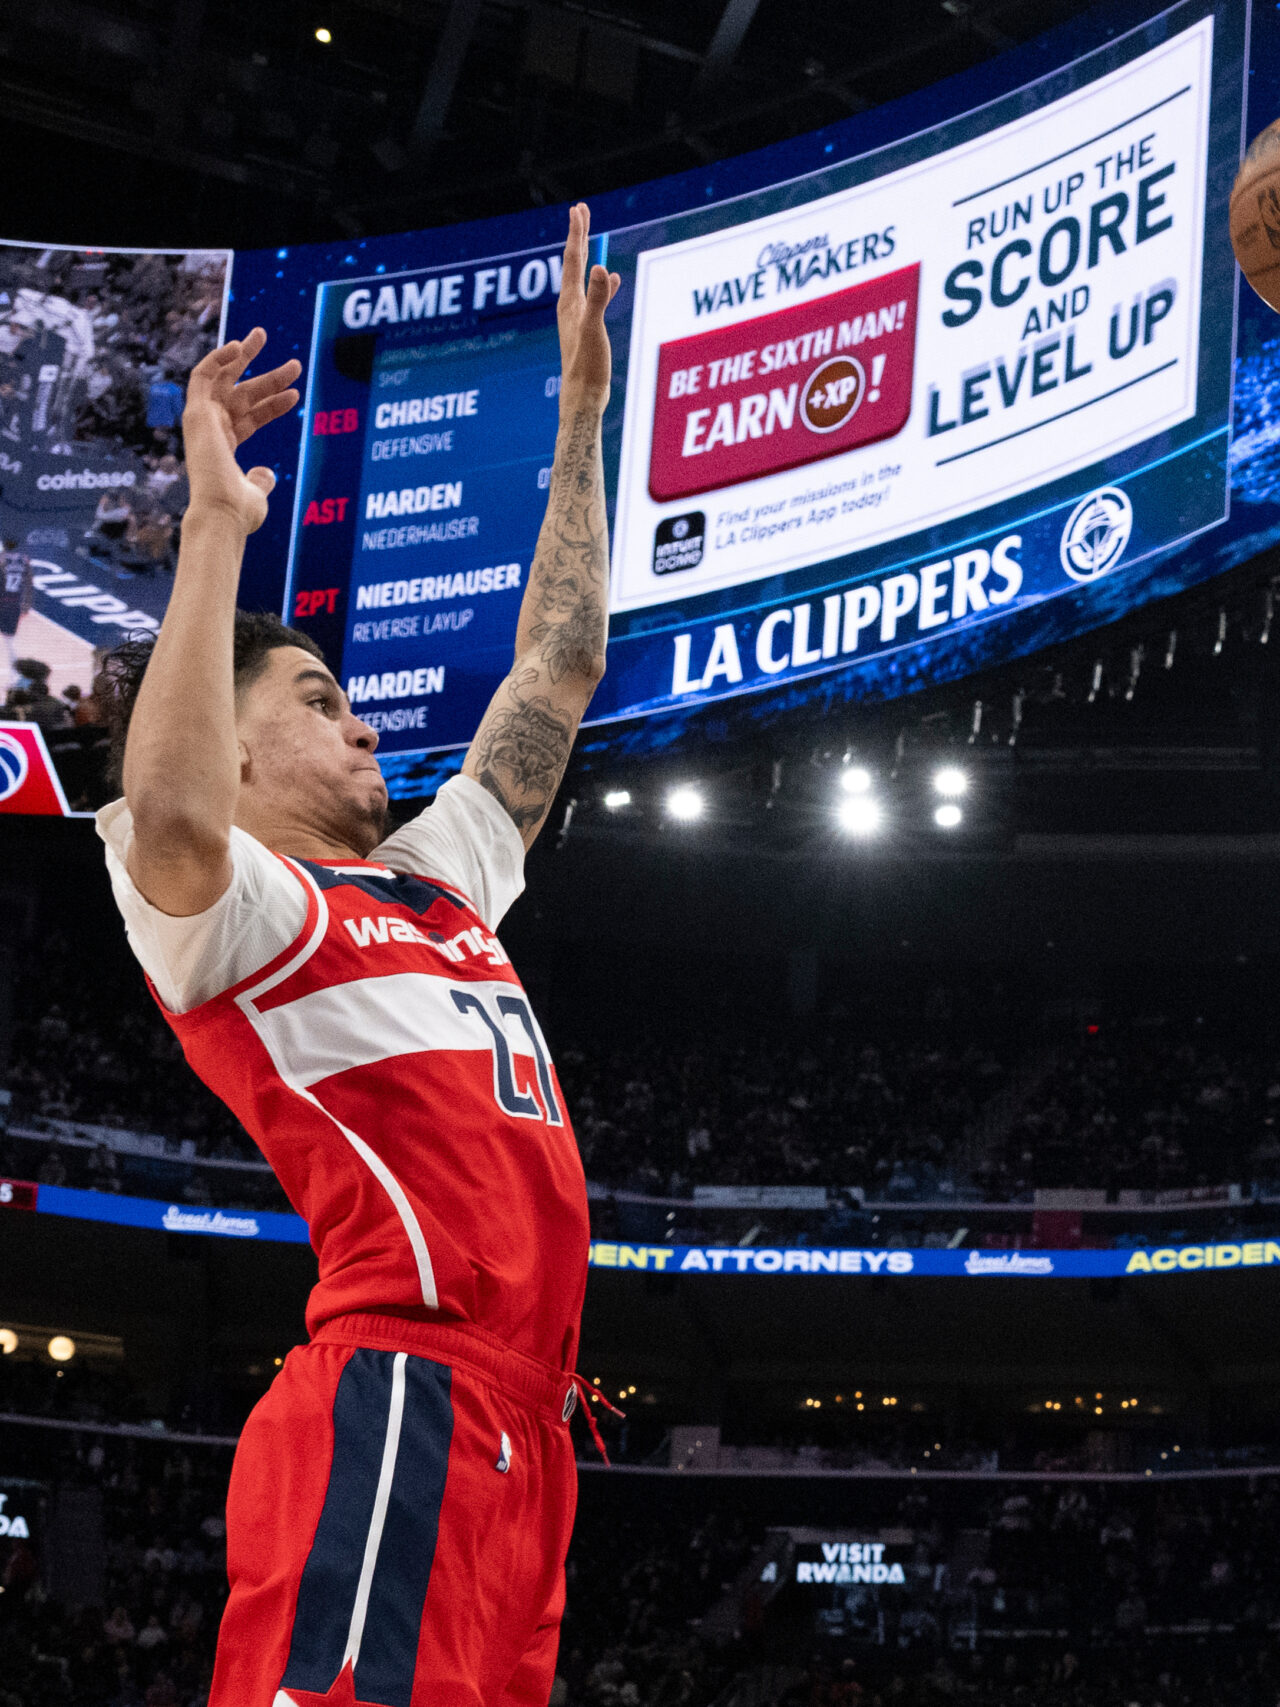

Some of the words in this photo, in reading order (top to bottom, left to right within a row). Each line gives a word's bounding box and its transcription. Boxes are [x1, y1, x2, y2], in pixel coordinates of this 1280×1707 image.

[967, 194, 1033, 250] RUN
[1043, 172, 1085, 214] UP
[1094, 132, 1157, 189] THE
[941, 161, 1176, 329] SCORE
[692, 269, 767, 317] WAVE
[776, 225, 896, 294] MAKERS
[343, 275, 464, 329] GAME
[1021, 284, 1091, 341] AND
[668, 365, 704, 399] BE
[708, 350, 757, 389] THE
[758, 326, 834, 375] SIXTH
[836, 300, 908, 350] MAN!
[926, 330, 1093, 439] LEVEL
[1107, 287, 1177, 360] UP
[313, 408, 359, 436] REB
[375, 389, 480, 429] CHRISTIE
[681, 382, 799, 458] EARN
[808, 375, 857, 410] +XP
[371, 431, 455, 462] DEFENSIVE
[36, 468, 137, 491] coinbase
[303, 498, 349, 526] AST
[365, 481, 463, 520] HARDEN
[716, 509, 750, 527] Find
[754, 500, 786, 520] your
[860, 471, 875, 486] in
[877, 464, 902, 482] the
[361, 516, 480, 551] NIEDERHAUSER
[714, 533, 737, 551] LA
[740, 515, 802, 543] Clippers
[806, 506, 835, 526] App
[294, 588, 340, 617] 2PT
[355, 563, 522, 610] NIEDERHAUSER
[352, 615, 420, 643] REVERSE
[423, 608, 474, 636] LAYUP
[671, 623, 744, 696] LA
[756, 535, 1024, 675] CLIPPERS
[347, 665, 445, 703] HARDEN
[588, 1243, 674, 1270] ENT
[680, 1249, 914, 1273] ATTORNEYS
[796, 1562, 905, 1584] RWANDA
[821, 1542, 886, 1564] VISIT
